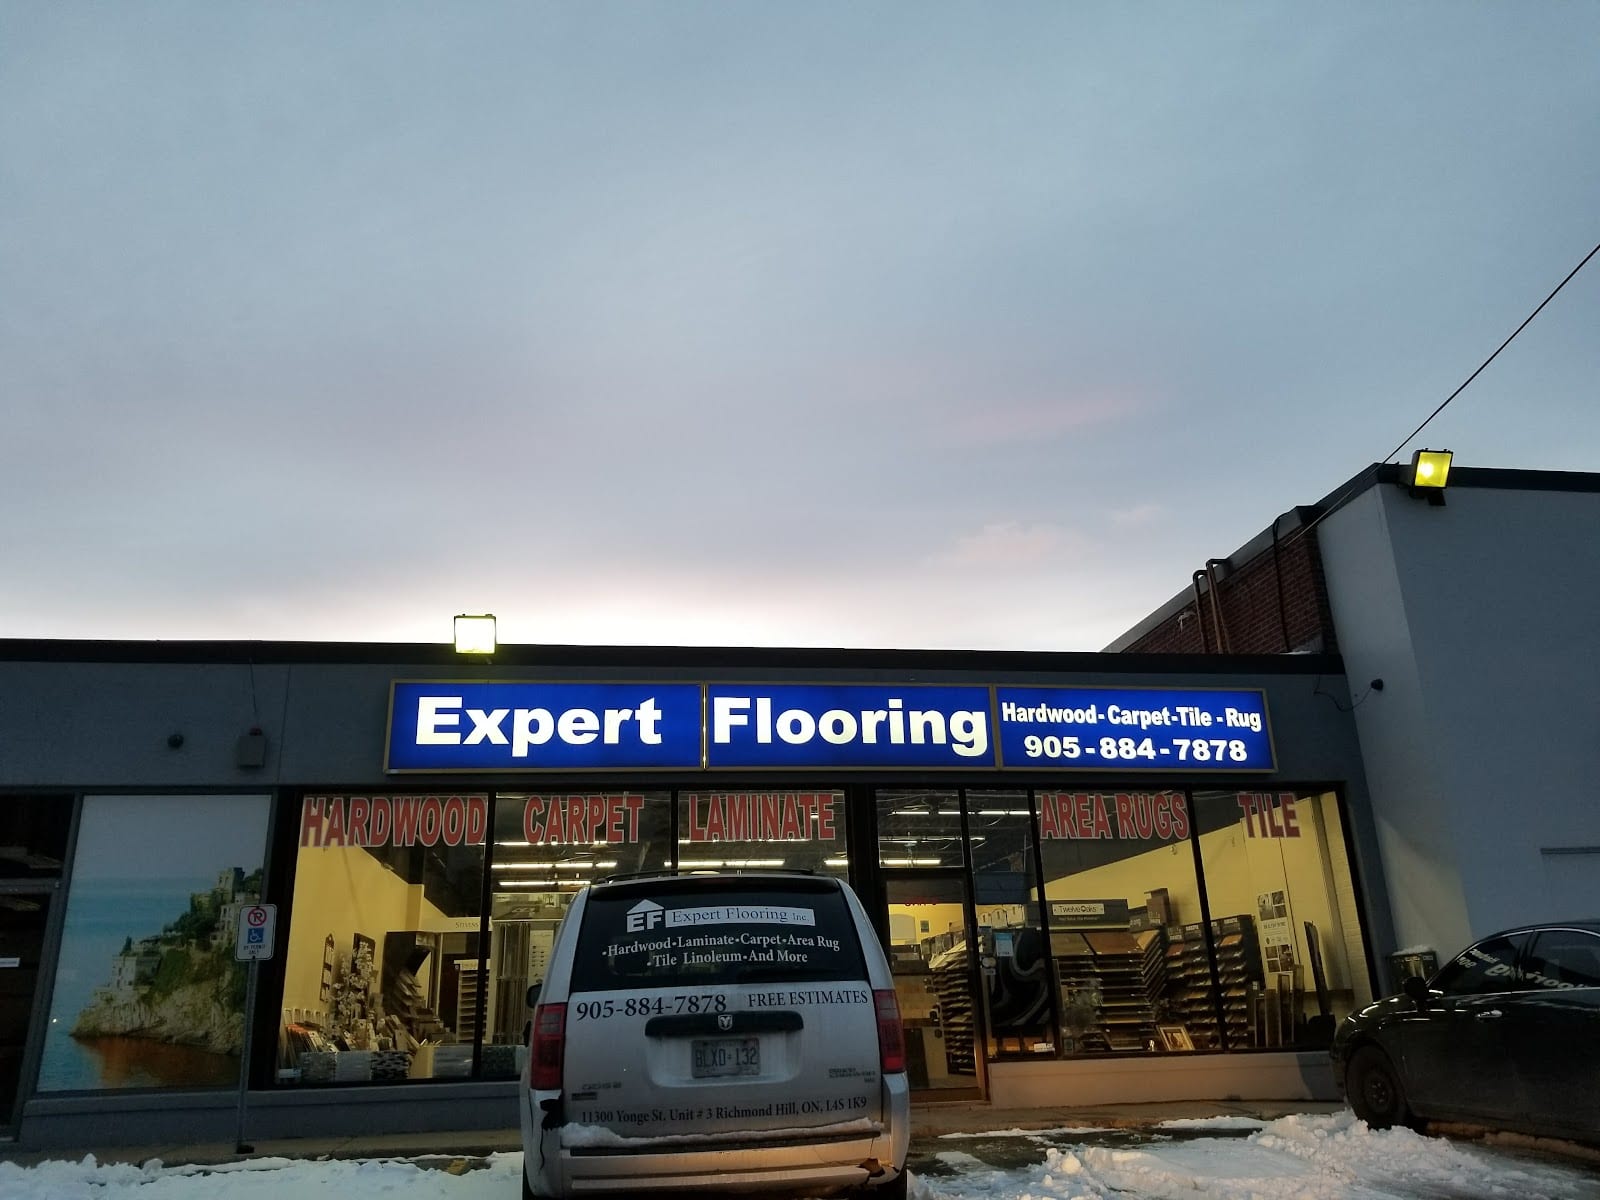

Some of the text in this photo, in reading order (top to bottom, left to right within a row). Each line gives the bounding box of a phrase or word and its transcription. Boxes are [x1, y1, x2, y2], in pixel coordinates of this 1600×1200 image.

[416, 696, 988, 757] Expert Flooring
[300, 796, 488, 847] HARDWOOD
[523, 794, 645, 846] CARPET
[688, 793, 836, 841] LAMINATE
[1039, 793, 1190, 840] AREA RUGS
[1237, 791, 1301, 839] TILE
[626, 910, 664, 933] EF
[672, 909, 721, 924] Expert
[725, 907, 789, 923] Flooring
[683, 949, 742, 964] Linoleum
[748, 948, 775, 963] And
[777, 949, 809, 963] More
[817, 935, 841, 952] Rug
[576, 994, 727, 1021] 905-884-7878
[748, 989, 869, 1008] FREE ESTIMATES
[581, 1110, 614, 1124] 11300
[616, 1109, 650, 1126] Yonge
[669, 1107, 694, 1121] Unit
[706, 1107, 714, 1119] 3
[715, 1103, 772, 1120] Richmond
